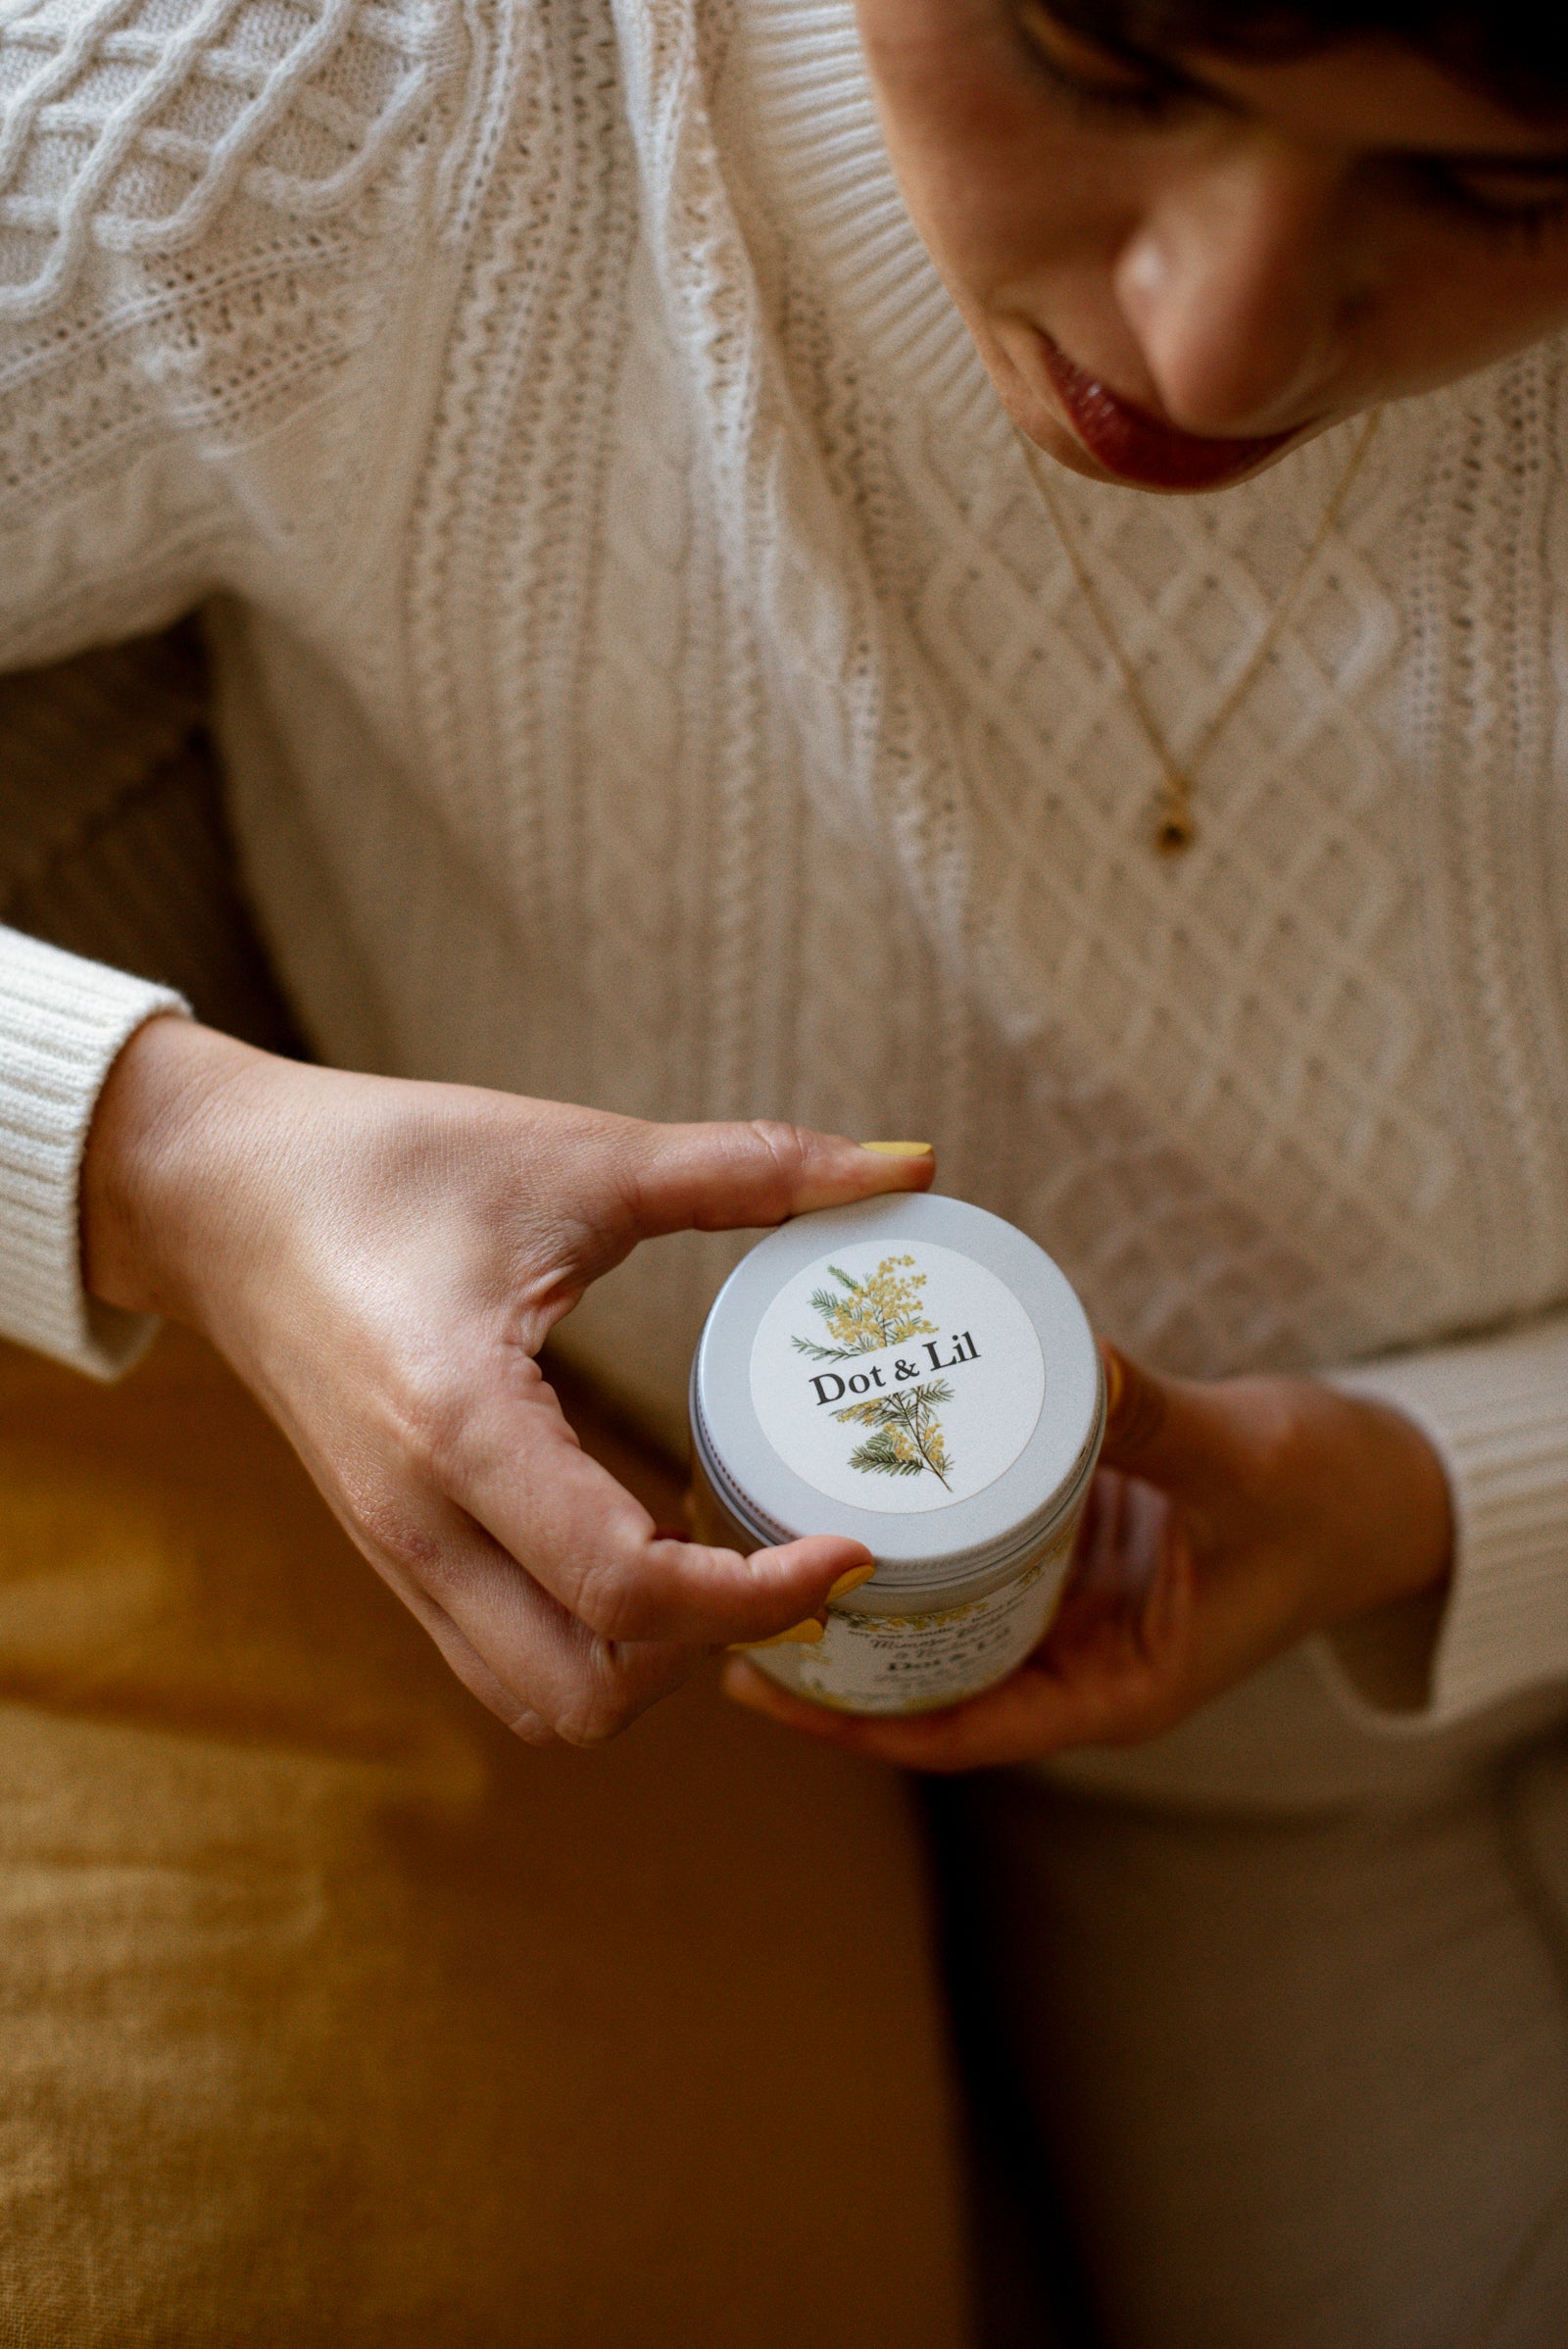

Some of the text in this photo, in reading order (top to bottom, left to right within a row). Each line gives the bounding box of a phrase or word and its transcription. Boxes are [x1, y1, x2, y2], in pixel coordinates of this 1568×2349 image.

[808, 1331, 982, 1406] Dot & Lil
